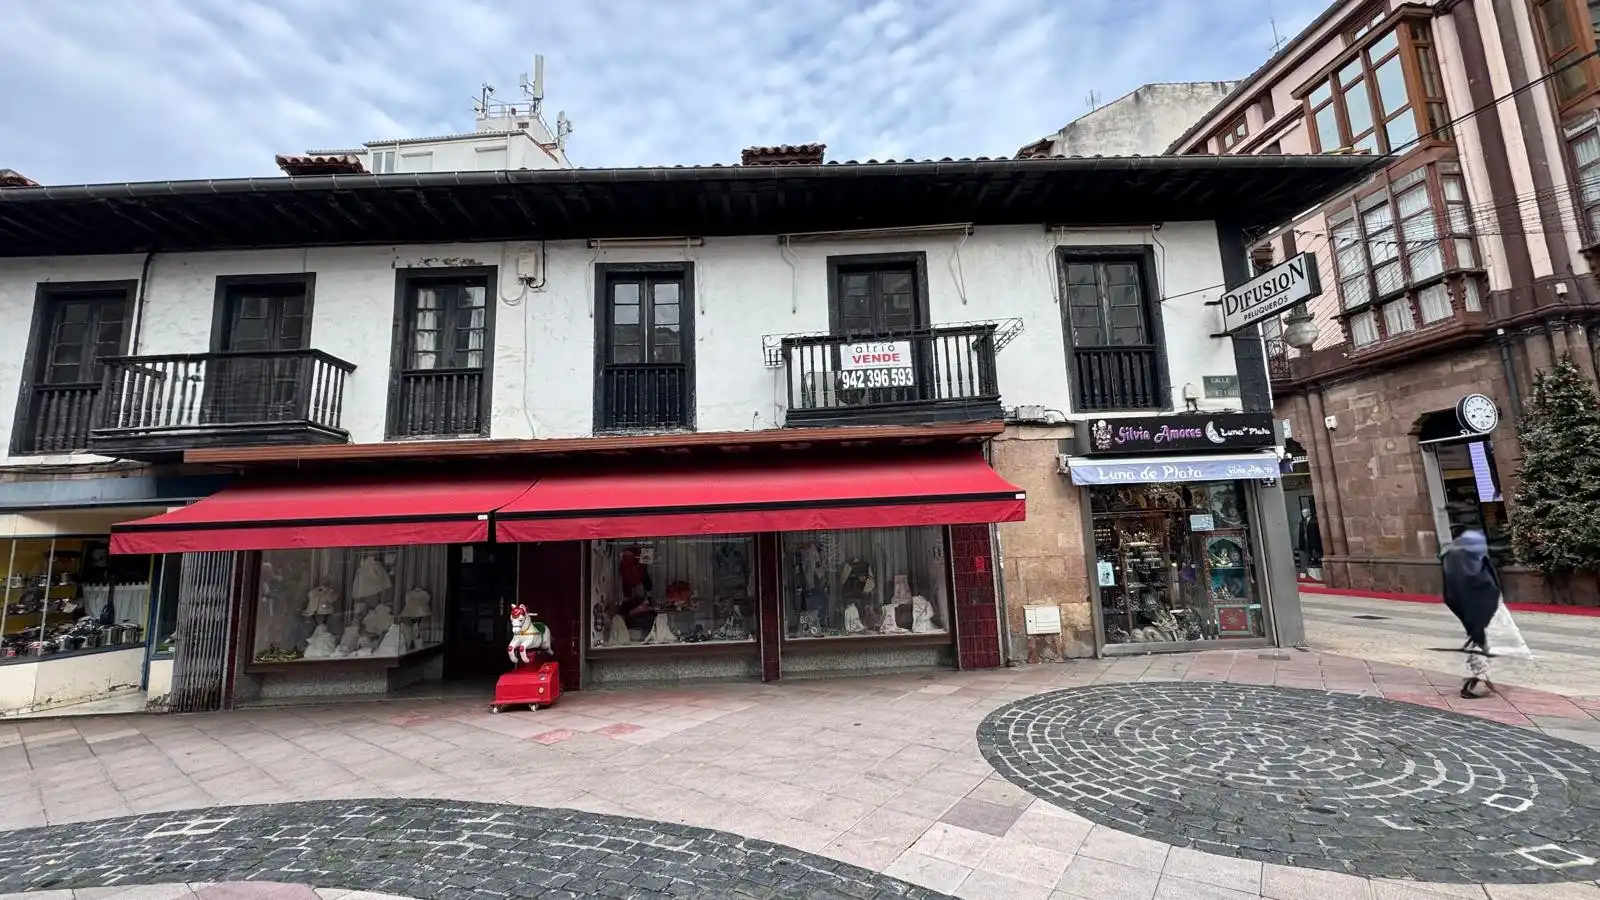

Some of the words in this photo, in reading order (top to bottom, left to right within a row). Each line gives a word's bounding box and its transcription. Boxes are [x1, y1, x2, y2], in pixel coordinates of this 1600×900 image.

[1224, 257, 1304, 317] DIFUSION
[1243, 295, 1289, 321] PELUQUEROS
[852, 353, 901, 363] VENDE
[841, 370, 865, 389] 942
[866, 368, 889, 388] 396
[890, 367, 914, 386] 593
[1115, 425, 1151, 445] Silvia
[1153, 424, 1203, 444] Amores
[1219, 427, 1244, 437] Luna
[1248, 427, 1271, 436] Plata
[1097, 466, 1135, 480] Luna
[1140, 466, 1157, 480] de
[1162, 465, 1203, 480] Plata
